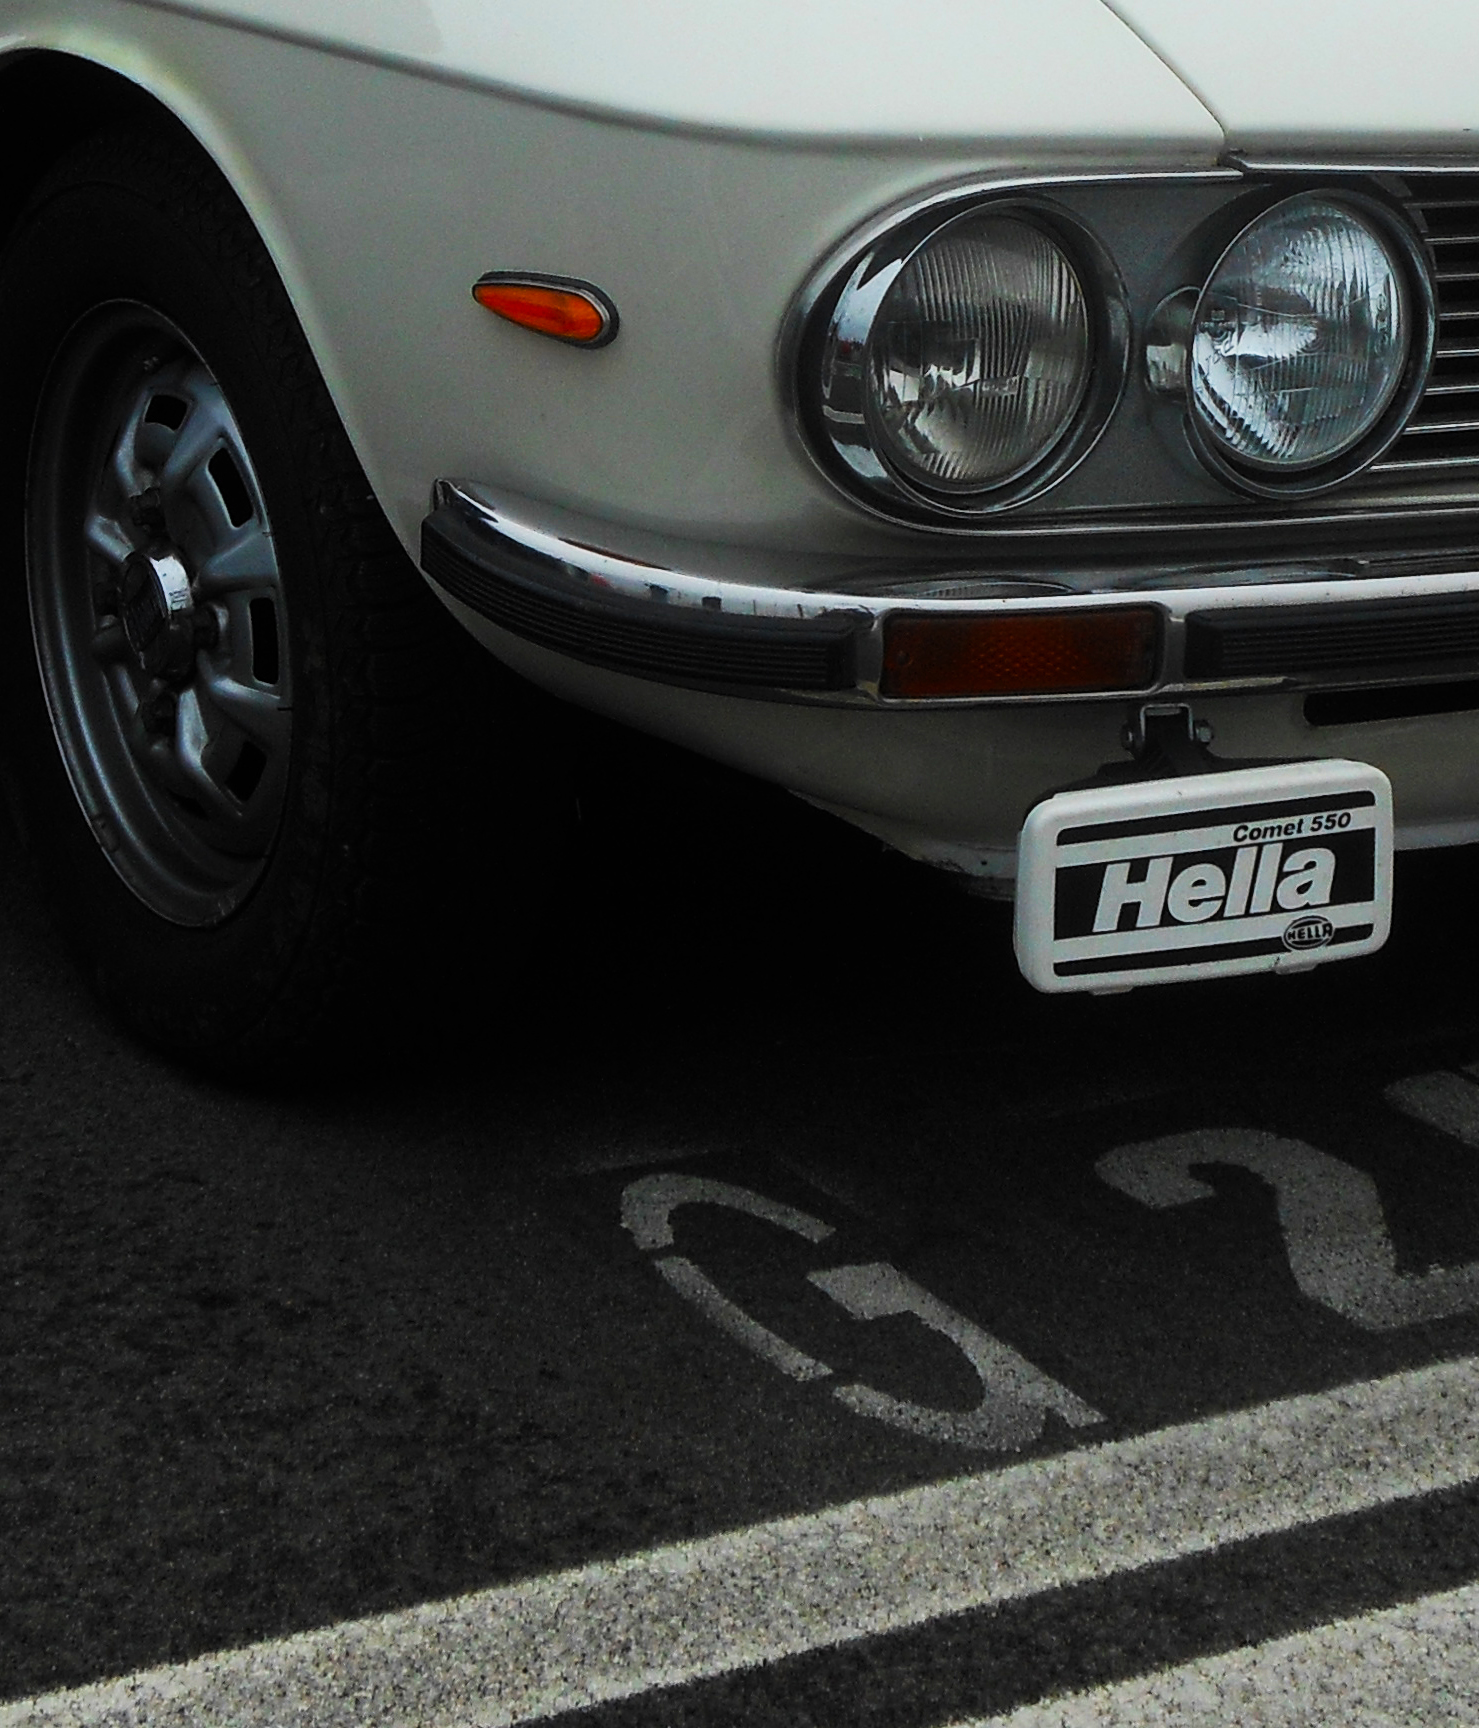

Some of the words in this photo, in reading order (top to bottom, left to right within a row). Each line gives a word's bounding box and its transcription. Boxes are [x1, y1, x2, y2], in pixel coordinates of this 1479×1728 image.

[1233, 817, 1304, 842] Comet
[1310, 812, 1351, 833] 550
[1092, 842, 1336, 933] Hella
[1287, 923, 1333, 940] HELLA
